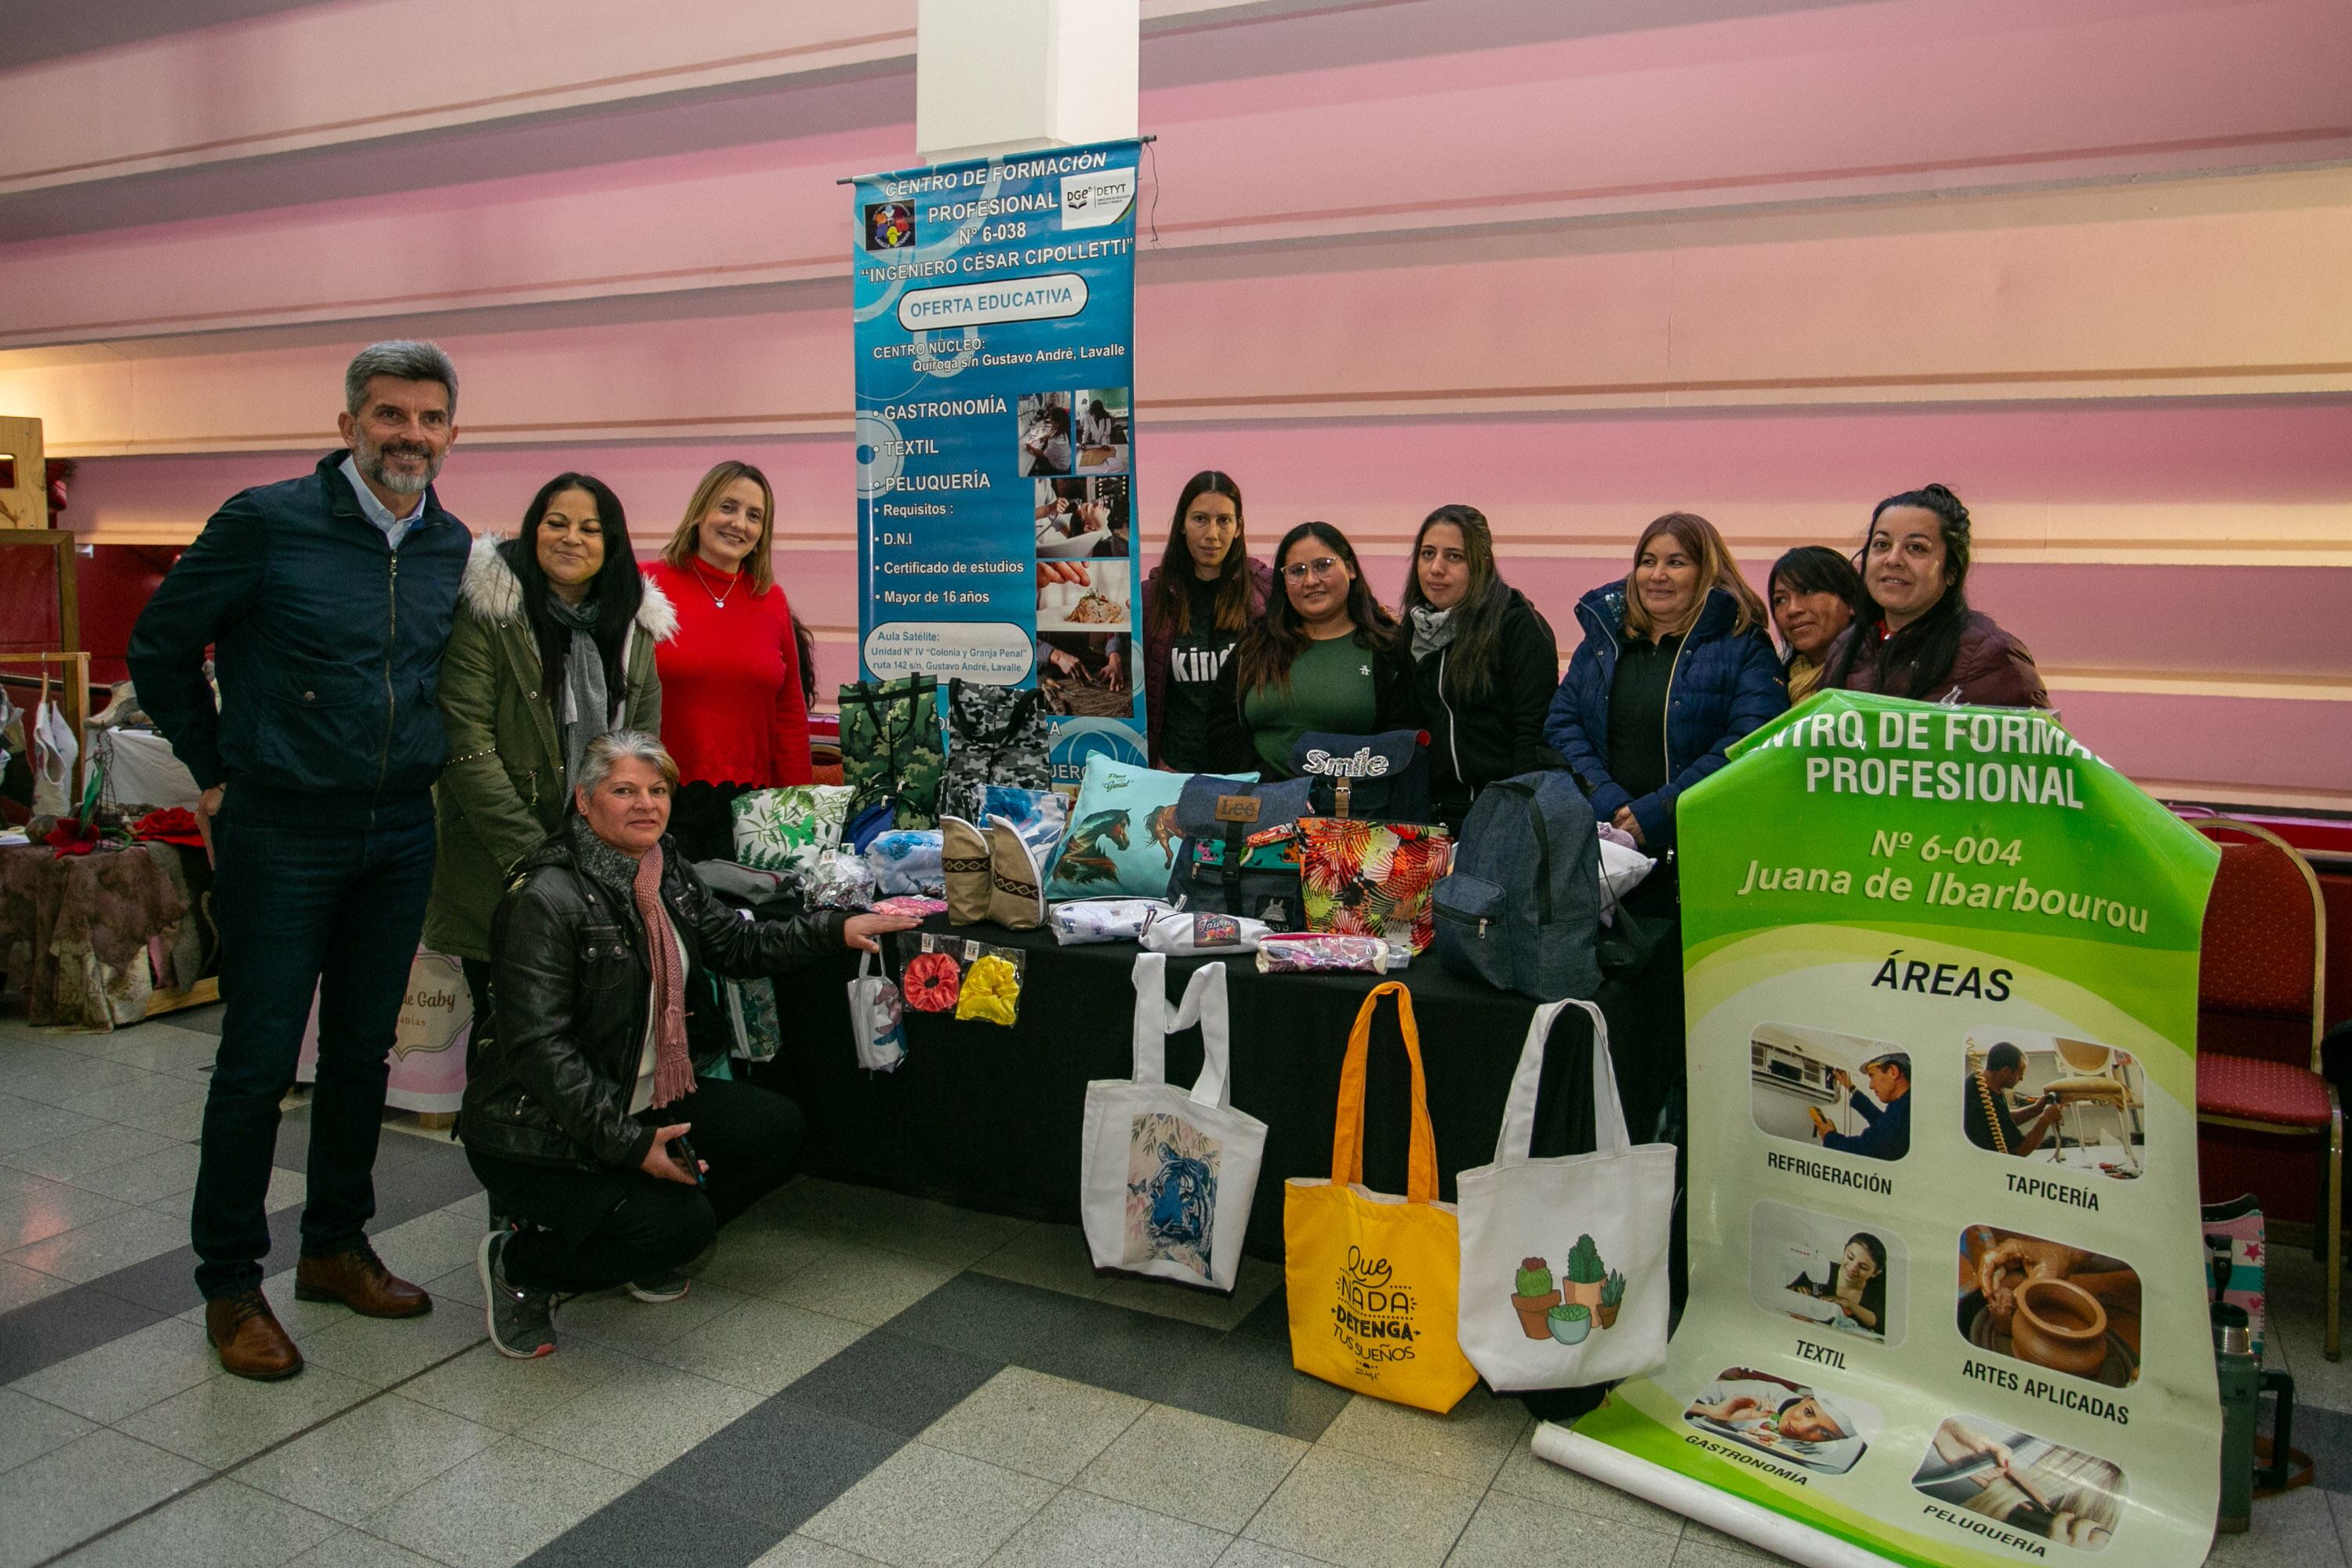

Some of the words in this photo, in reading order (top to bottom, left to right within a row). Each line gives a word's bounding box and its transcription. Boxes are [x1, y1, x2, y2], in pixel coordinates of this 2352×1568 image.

[885, 173, 957, 197] CENTRO
[963, 167, 987, 187] DE
[992, 151, 1107, 183] FORMACIÓN
[1097, 183, 1126, 196] DETYT
[928, 192, 1058, 223] PROFESIONAL
[982, 222, 1026, 242] 6-038
[861, 258, 957, 283] “INGENIERO
[963, 248, 1019, 272] CÉSAR
[1025, 237, 1134, 265] CIPOLLETTI”
[911, 297, 973, 317] OFERTA
[978, 287, 1073, 311] EDUCATIVA
[873, 343, 925, 359] CENTRO
[929, 337, 985, 355] NÚCLEO:
[913, 358, 958, 372] Quiroga
[961, 356, 978, 368] s/n
[982, 352, 1033, 366] Gustavo
[1035, 347, 1076, 363] André,
[1080, 343, 1125, 358] Lavalle
[884, 394, 1007, 420] GASTRONOMÍA
[884, 440, 939, 456] TEXTIL
[884, 470, 991, 492] PELUQUERÍA
[884, 504, 946, 518] Requisitos
[884, 532, 912, 546] D.N.I
[884, 561, 949, 575] Certificado
[953, 562, 967, 574] de
[971, 561, 1024, 574] estudios
[884, 591, 921, 606] Mayor
[924, 591, 939, 603] de
[943, 591, 956, 603] 16
[959, 590, 989, 603] años
[877, 631, 900, 641] Aula
[902, 631, 940, 641] Satélite:
[962, 662, 989, 672] André,
[970, 648, 997, 659] Granja
[1879, 712, 1929, 750] DE
[1944, 713, 2114, 769] FORMA
[1302, 747, 1389, 777] Smile
[1806, 757, 2084, 809] PROFESIONAL
[1221, 799, 1256, 817] Lee
[1920, 835, 2023, 867] 6-004
[1737, 859, 1853, 896] Juana
[1864, 867, 1913, 901] de
[1926, 872, 2148, 935] Ibarbourou
[1871, 949, 2014, 1002] ÁREAS
[418, 989, 456, 1013] Gaby
[1767, 1152, 1893, 1196] REFRIGERACIÓN
[2005, 1173, 2100, 1211] TAPICERÍA
[1348, 1245, 1392, 1289] Que
[1341, 1275, 1409, 1314] NADA
[1336, 1304, 1414, 1341] DETENGA
[1334, 1323, 1354, 1350] TUS
[1355, 1343, 1415, 1363] SUEÑOS
[1795, 1339, 1846, 1370] TEXTIL
[1962, 1358, 2019, 1393] ARTES
[2024, 1377, 2129, 1426] APLICADAS
[1684, 1433, 1809, 1486] GASTRONOMÍA
[1922, 1504, 2046, 1558] PELUQUERÍA
